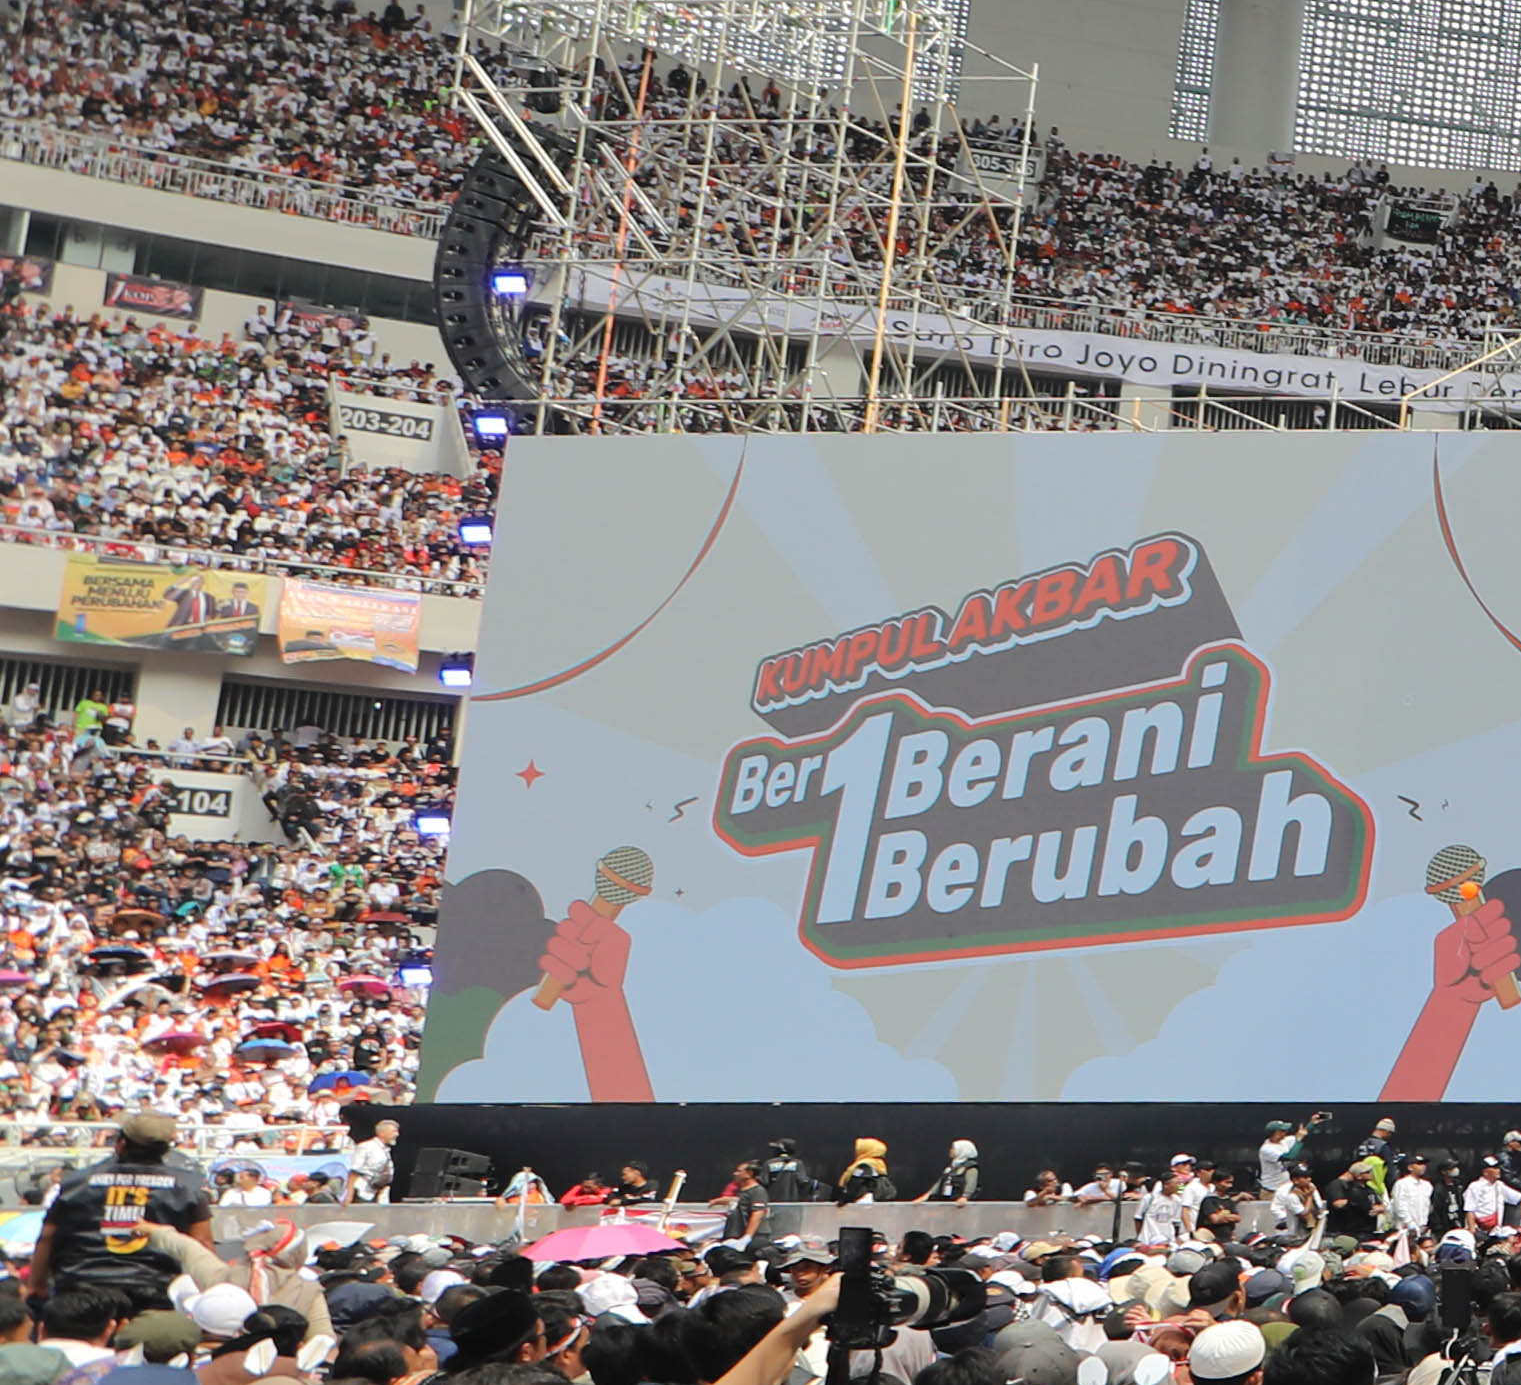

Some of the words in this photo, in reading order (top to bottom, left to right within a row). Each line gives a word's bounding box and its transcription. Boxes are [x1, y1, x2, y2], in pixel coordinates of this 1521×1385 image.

[1075, 344, 1158, 376] Joyo
[1172, 353, 1343, 395] Diningrat,
[341, 407, 432, 439] 203-204
[83, 575, 156, 589] BERSAMA
[755, 616, 946, 705] KUMPUL
[946, 536, 1181, 649] AKBAR
[883, 661, 1229, 820] Berani
[168, 789, 230, 816] -104
[863, 769, 1332, 921] Berubah
